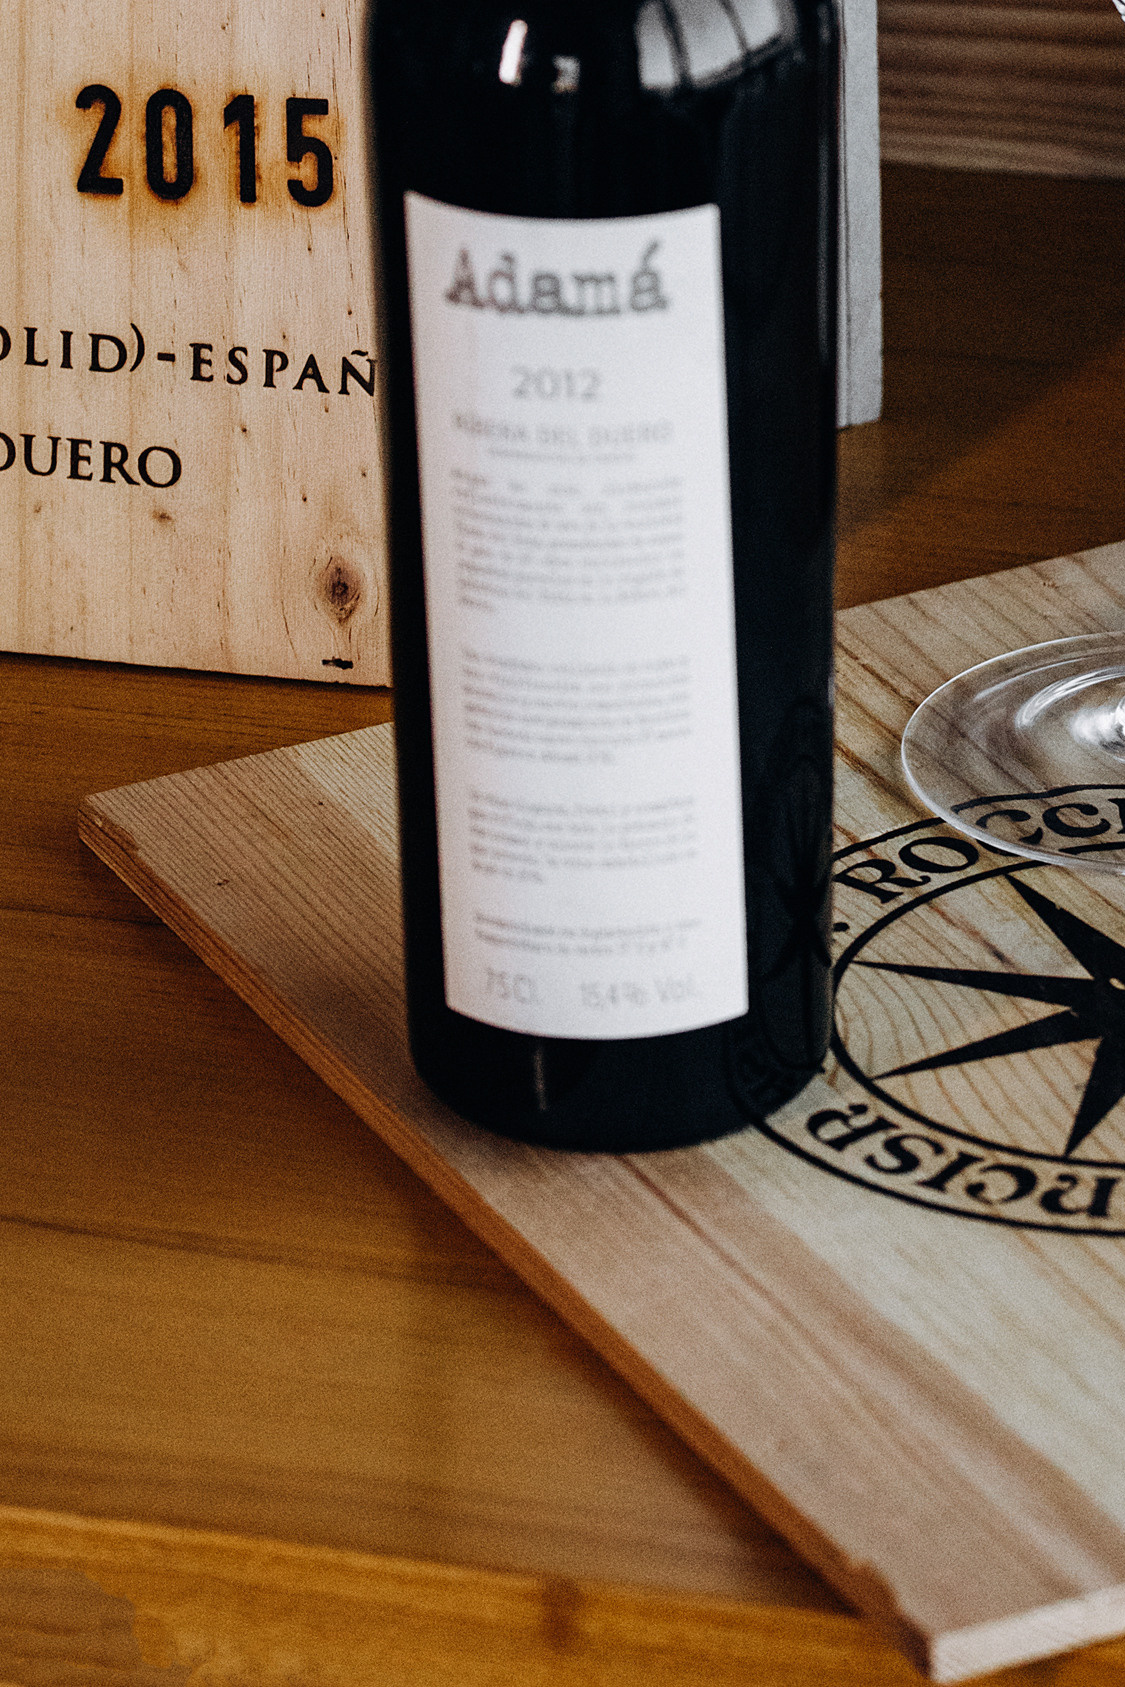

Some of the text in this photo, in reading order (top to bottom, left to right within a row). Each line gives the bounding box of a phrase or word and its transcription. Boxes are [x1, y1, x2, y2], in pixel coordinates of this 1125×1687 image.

[74, 83, 337, 208] 2015
[446, 235, 671, 317] Adamá
[510, 364, 602, 402] 2012
